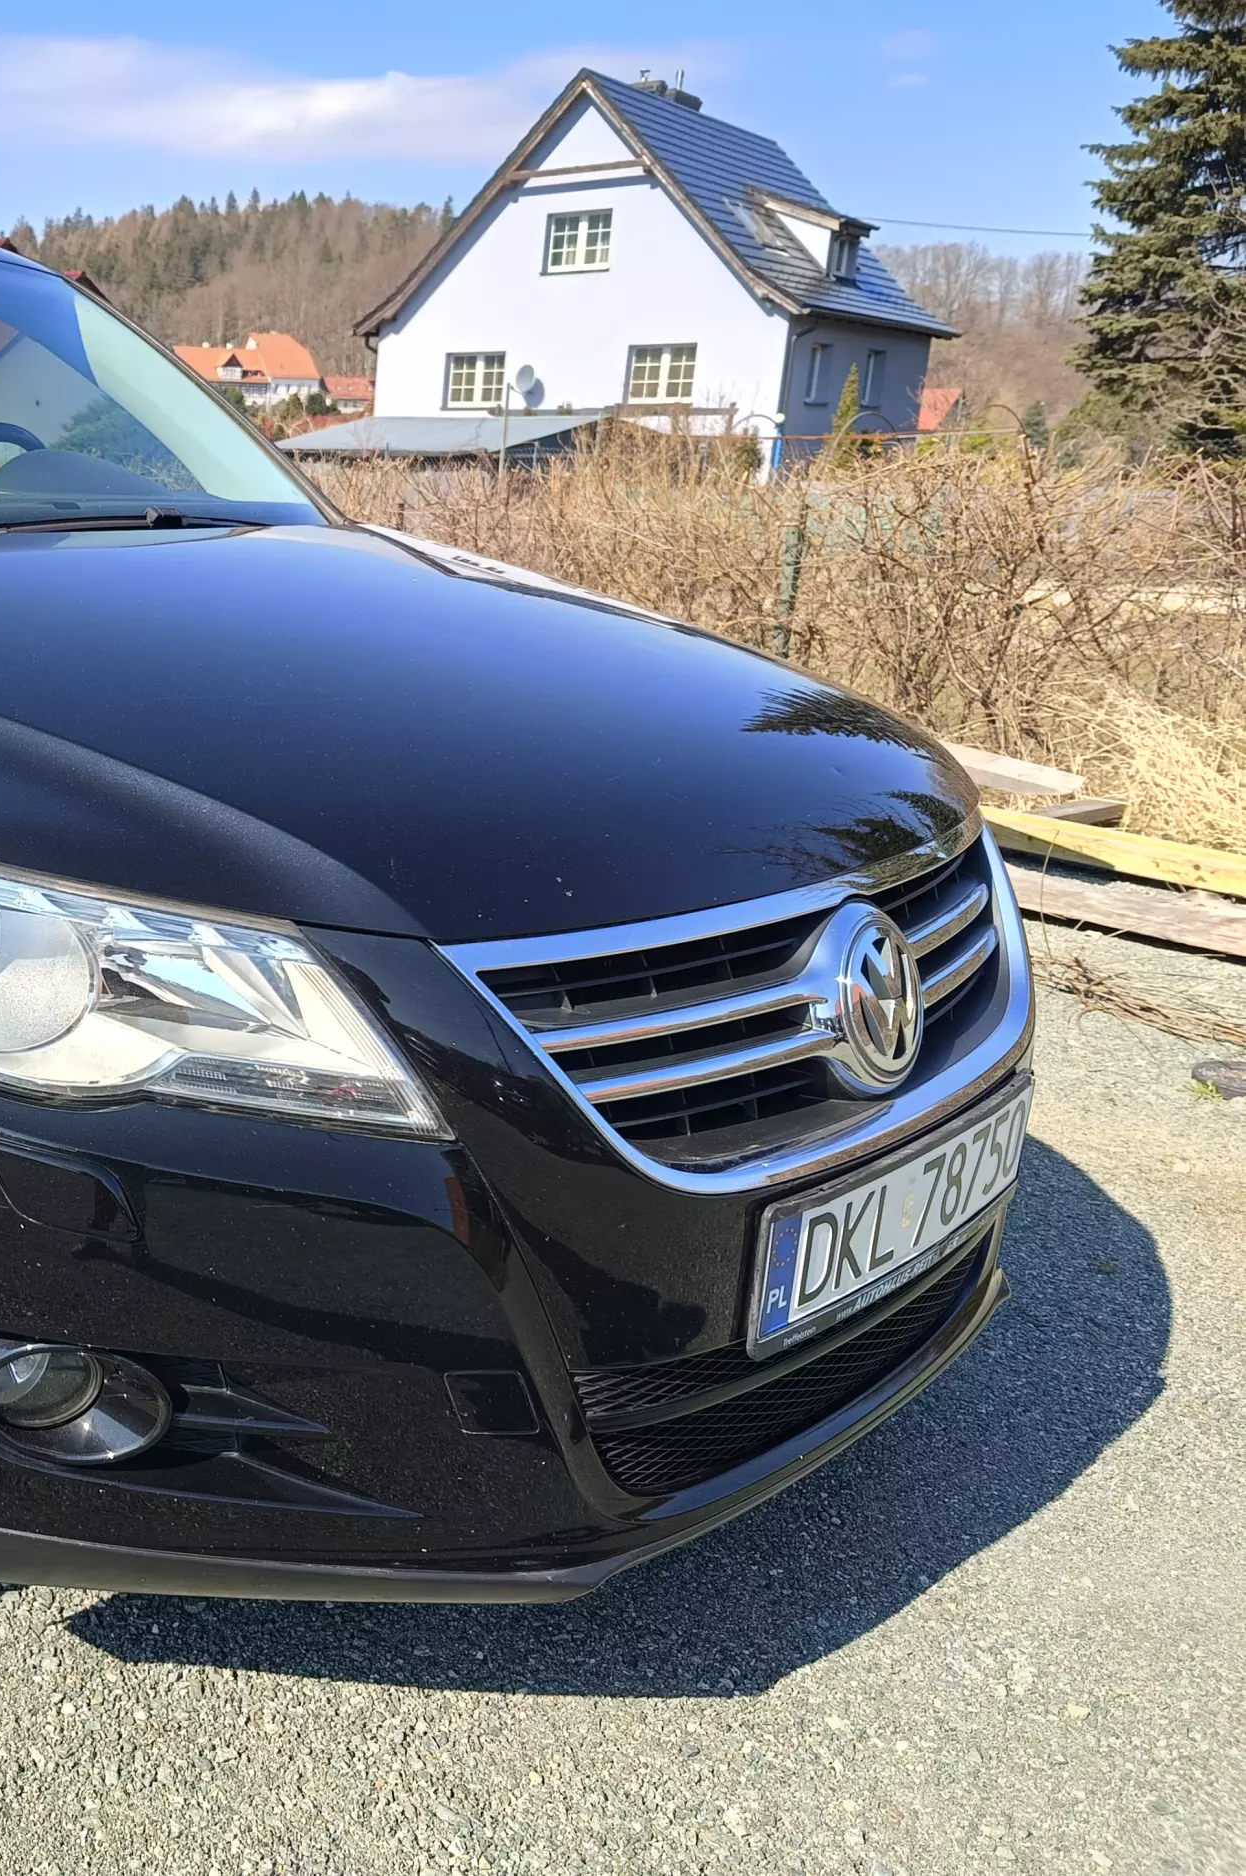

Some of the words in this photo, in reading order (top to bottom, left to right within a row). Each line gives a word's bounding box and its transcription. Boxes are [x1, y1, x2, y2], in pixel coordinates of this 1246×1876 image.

[766, 1284, 788, 1315] PL
[797, 1185, 895, 1309] DKL
[911, 1099, 1027, 1250] 78750
